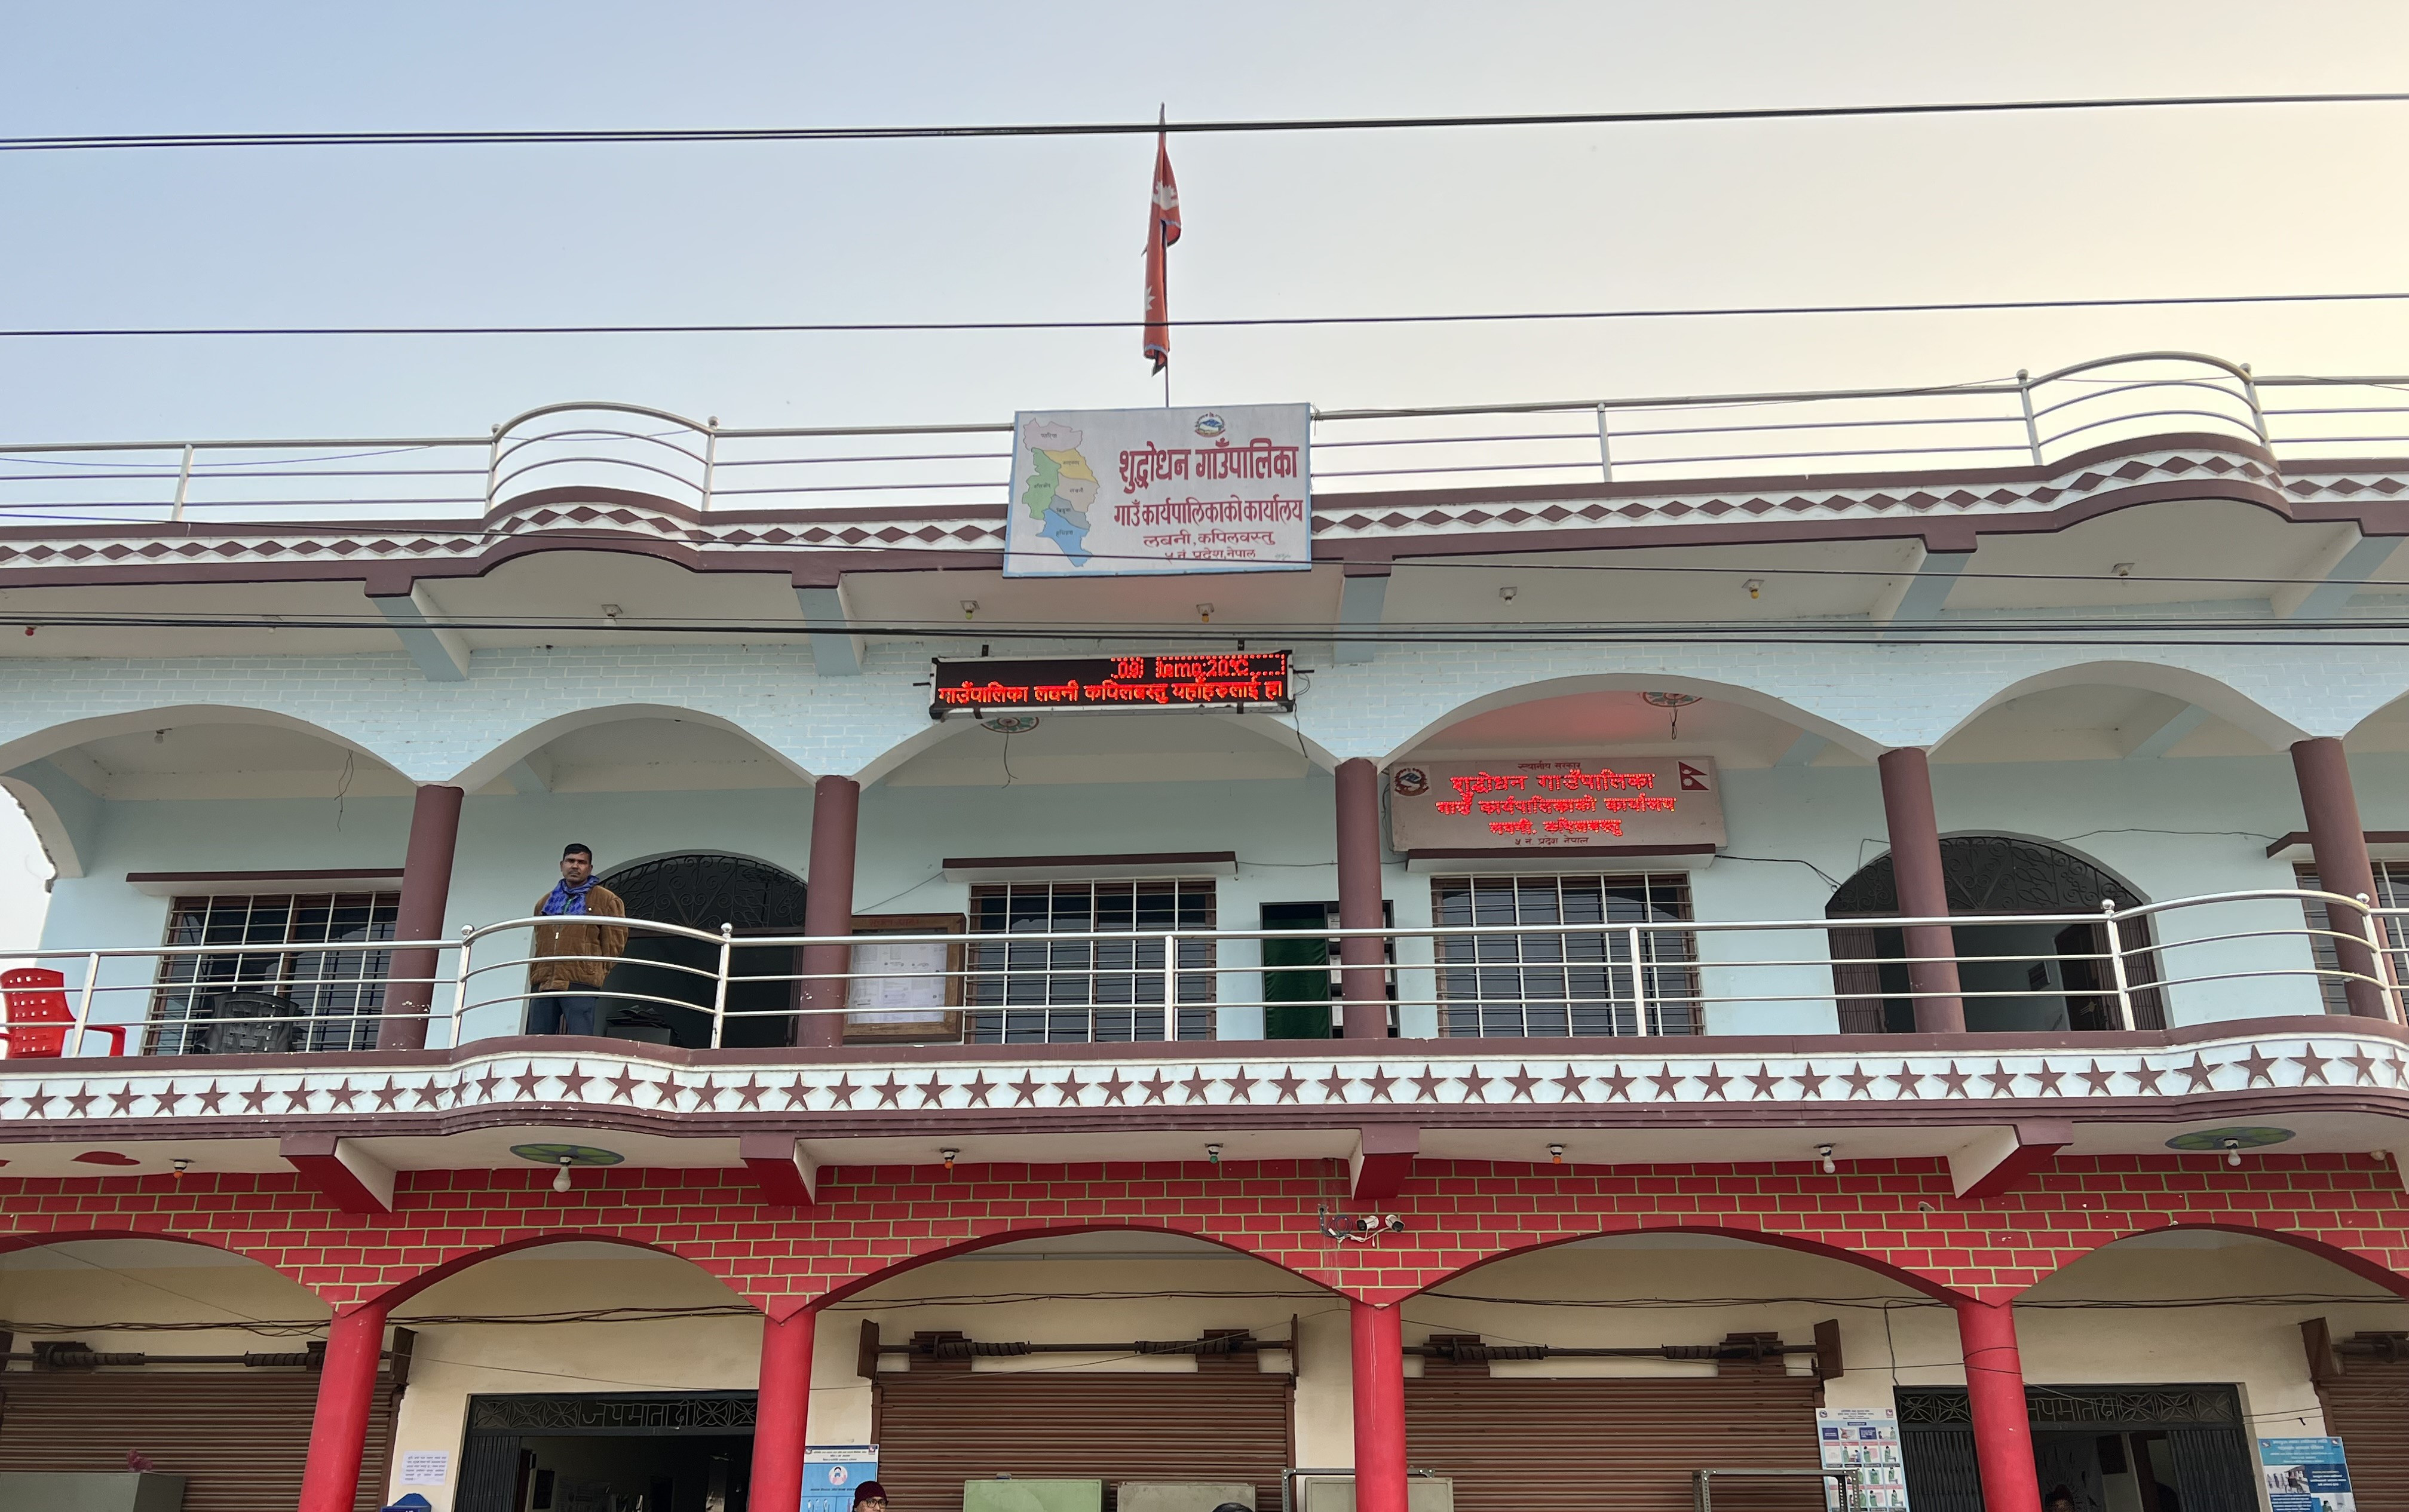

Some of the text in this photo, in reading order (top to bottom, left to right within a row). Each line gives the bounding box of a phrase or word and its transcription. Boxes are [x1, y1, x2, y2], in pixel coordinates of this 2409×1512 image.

[1195, 437, 1299, 480] गाउँपालिका
[1114, 494, 1304, 526] गाउँ कार्यपालिकाको कार्यालय
